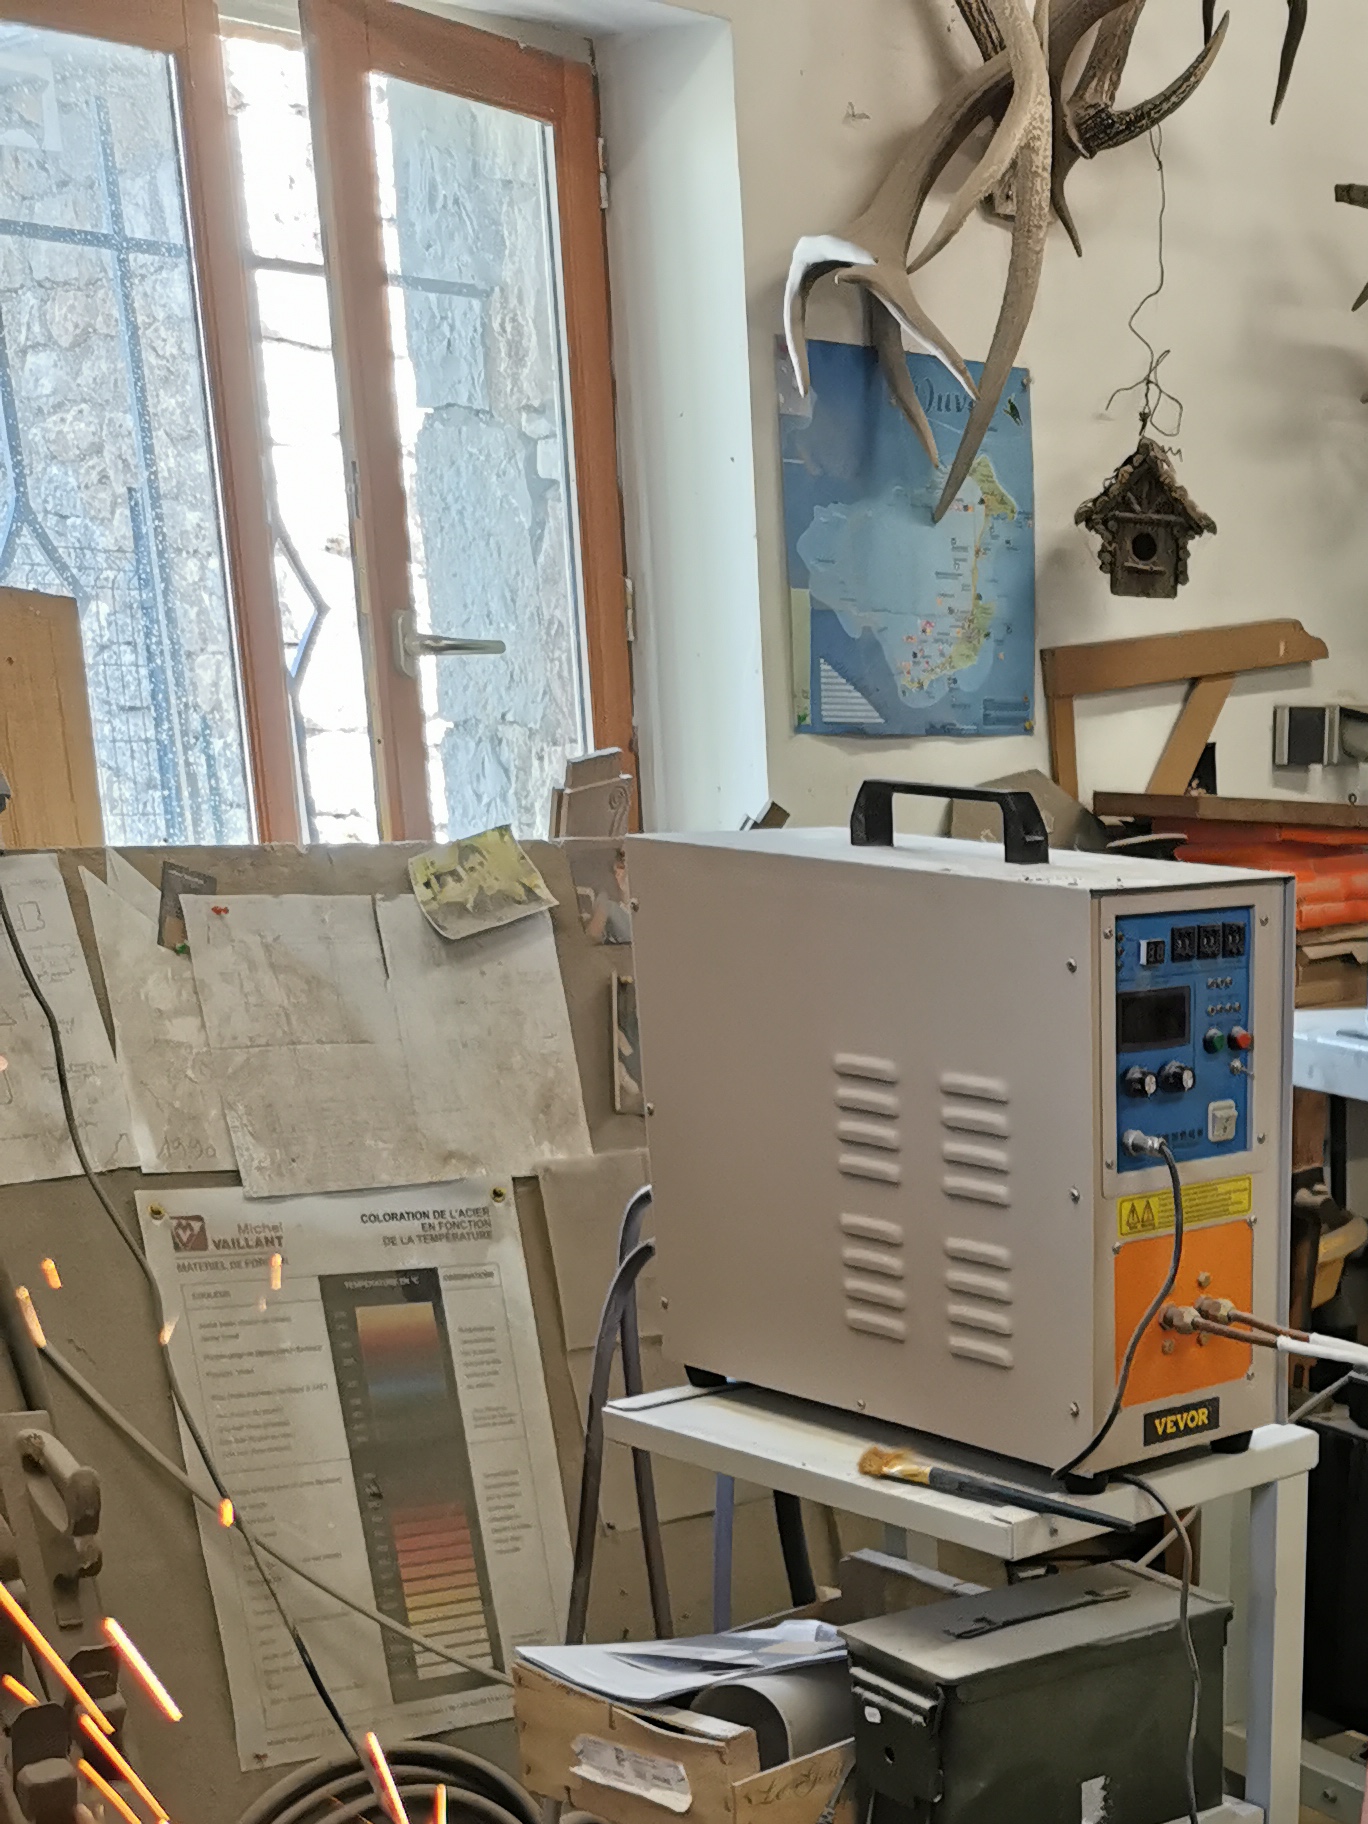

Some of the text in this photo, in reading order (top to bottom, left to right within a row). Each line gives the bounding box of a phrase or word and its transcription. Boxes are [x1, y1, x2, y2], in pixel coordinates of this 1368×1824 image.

[914, 378, 975, 413] Ouv
[360, 1206, 490, 1224] COLORATION DE L'ACIER
[237, 1221, 283, 1235] Michel
[421, 1217, 492, 1232] EN FONCTION
[211, 1235, 284, 1250] VAILLANT
[382, 1235, 398, 1247] DE
[400, 1235, 415, 1246] LA
[1154, 1407, 1209, 1436] VEVOR
